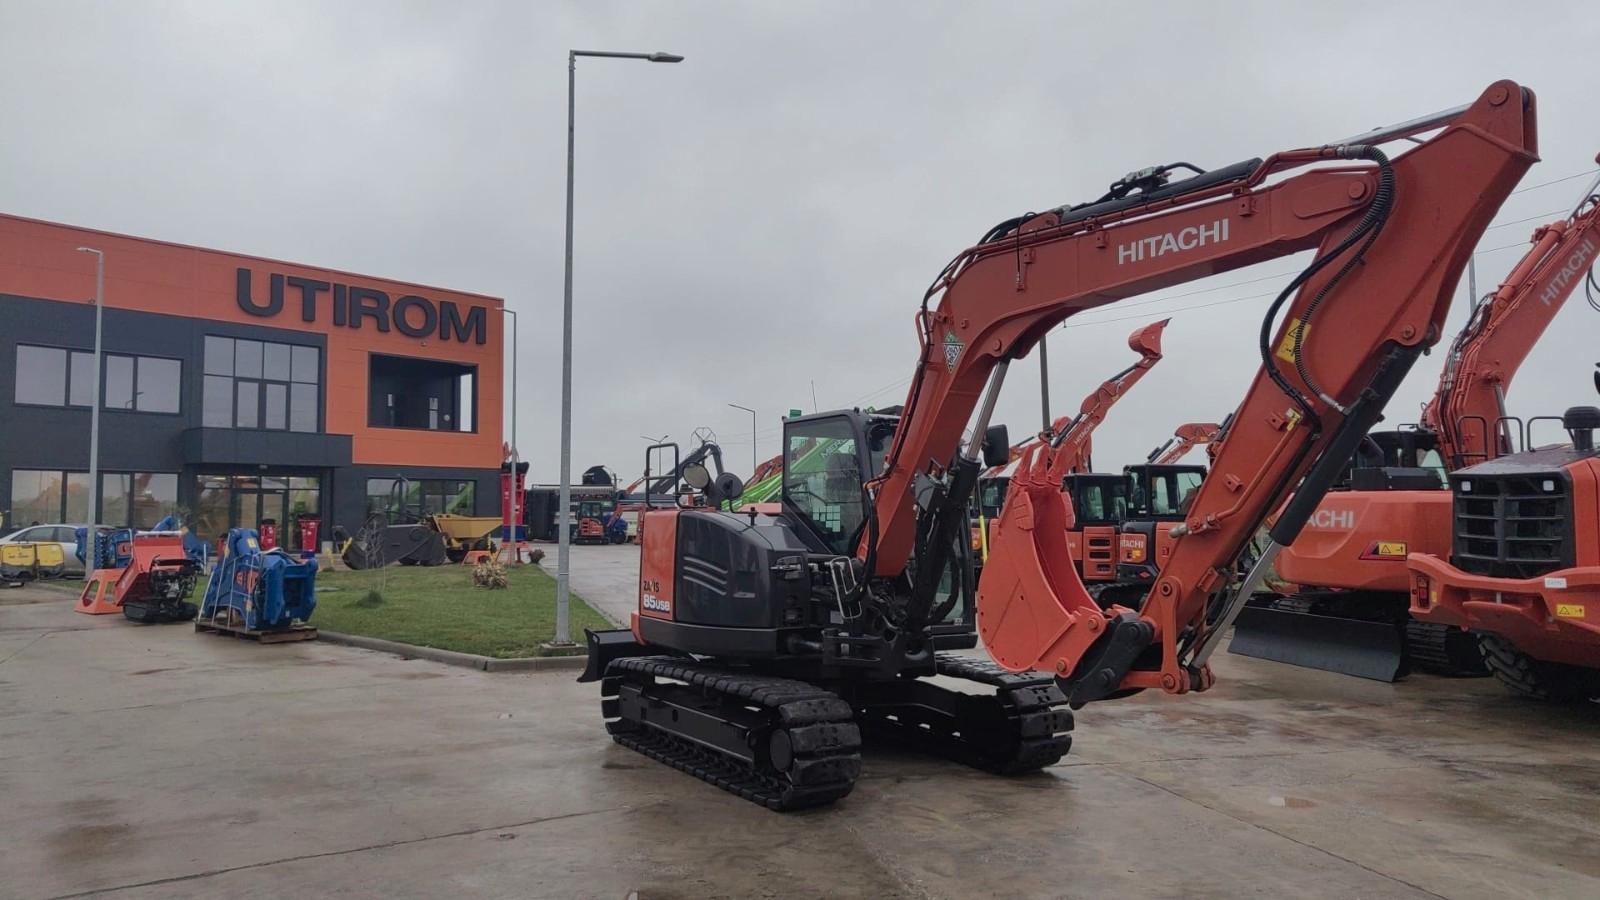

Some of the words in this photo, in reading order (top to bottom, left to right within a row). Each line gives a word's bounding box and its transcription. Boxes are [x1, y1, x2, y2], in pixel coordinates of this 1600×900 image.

[1118, 218, 1230, 265] HITACHI
[1540, 239, 1595, 305] HITACHI
[236, 267, 487, 345] UTIROM
[643, 593, 671, 611] 85USB
